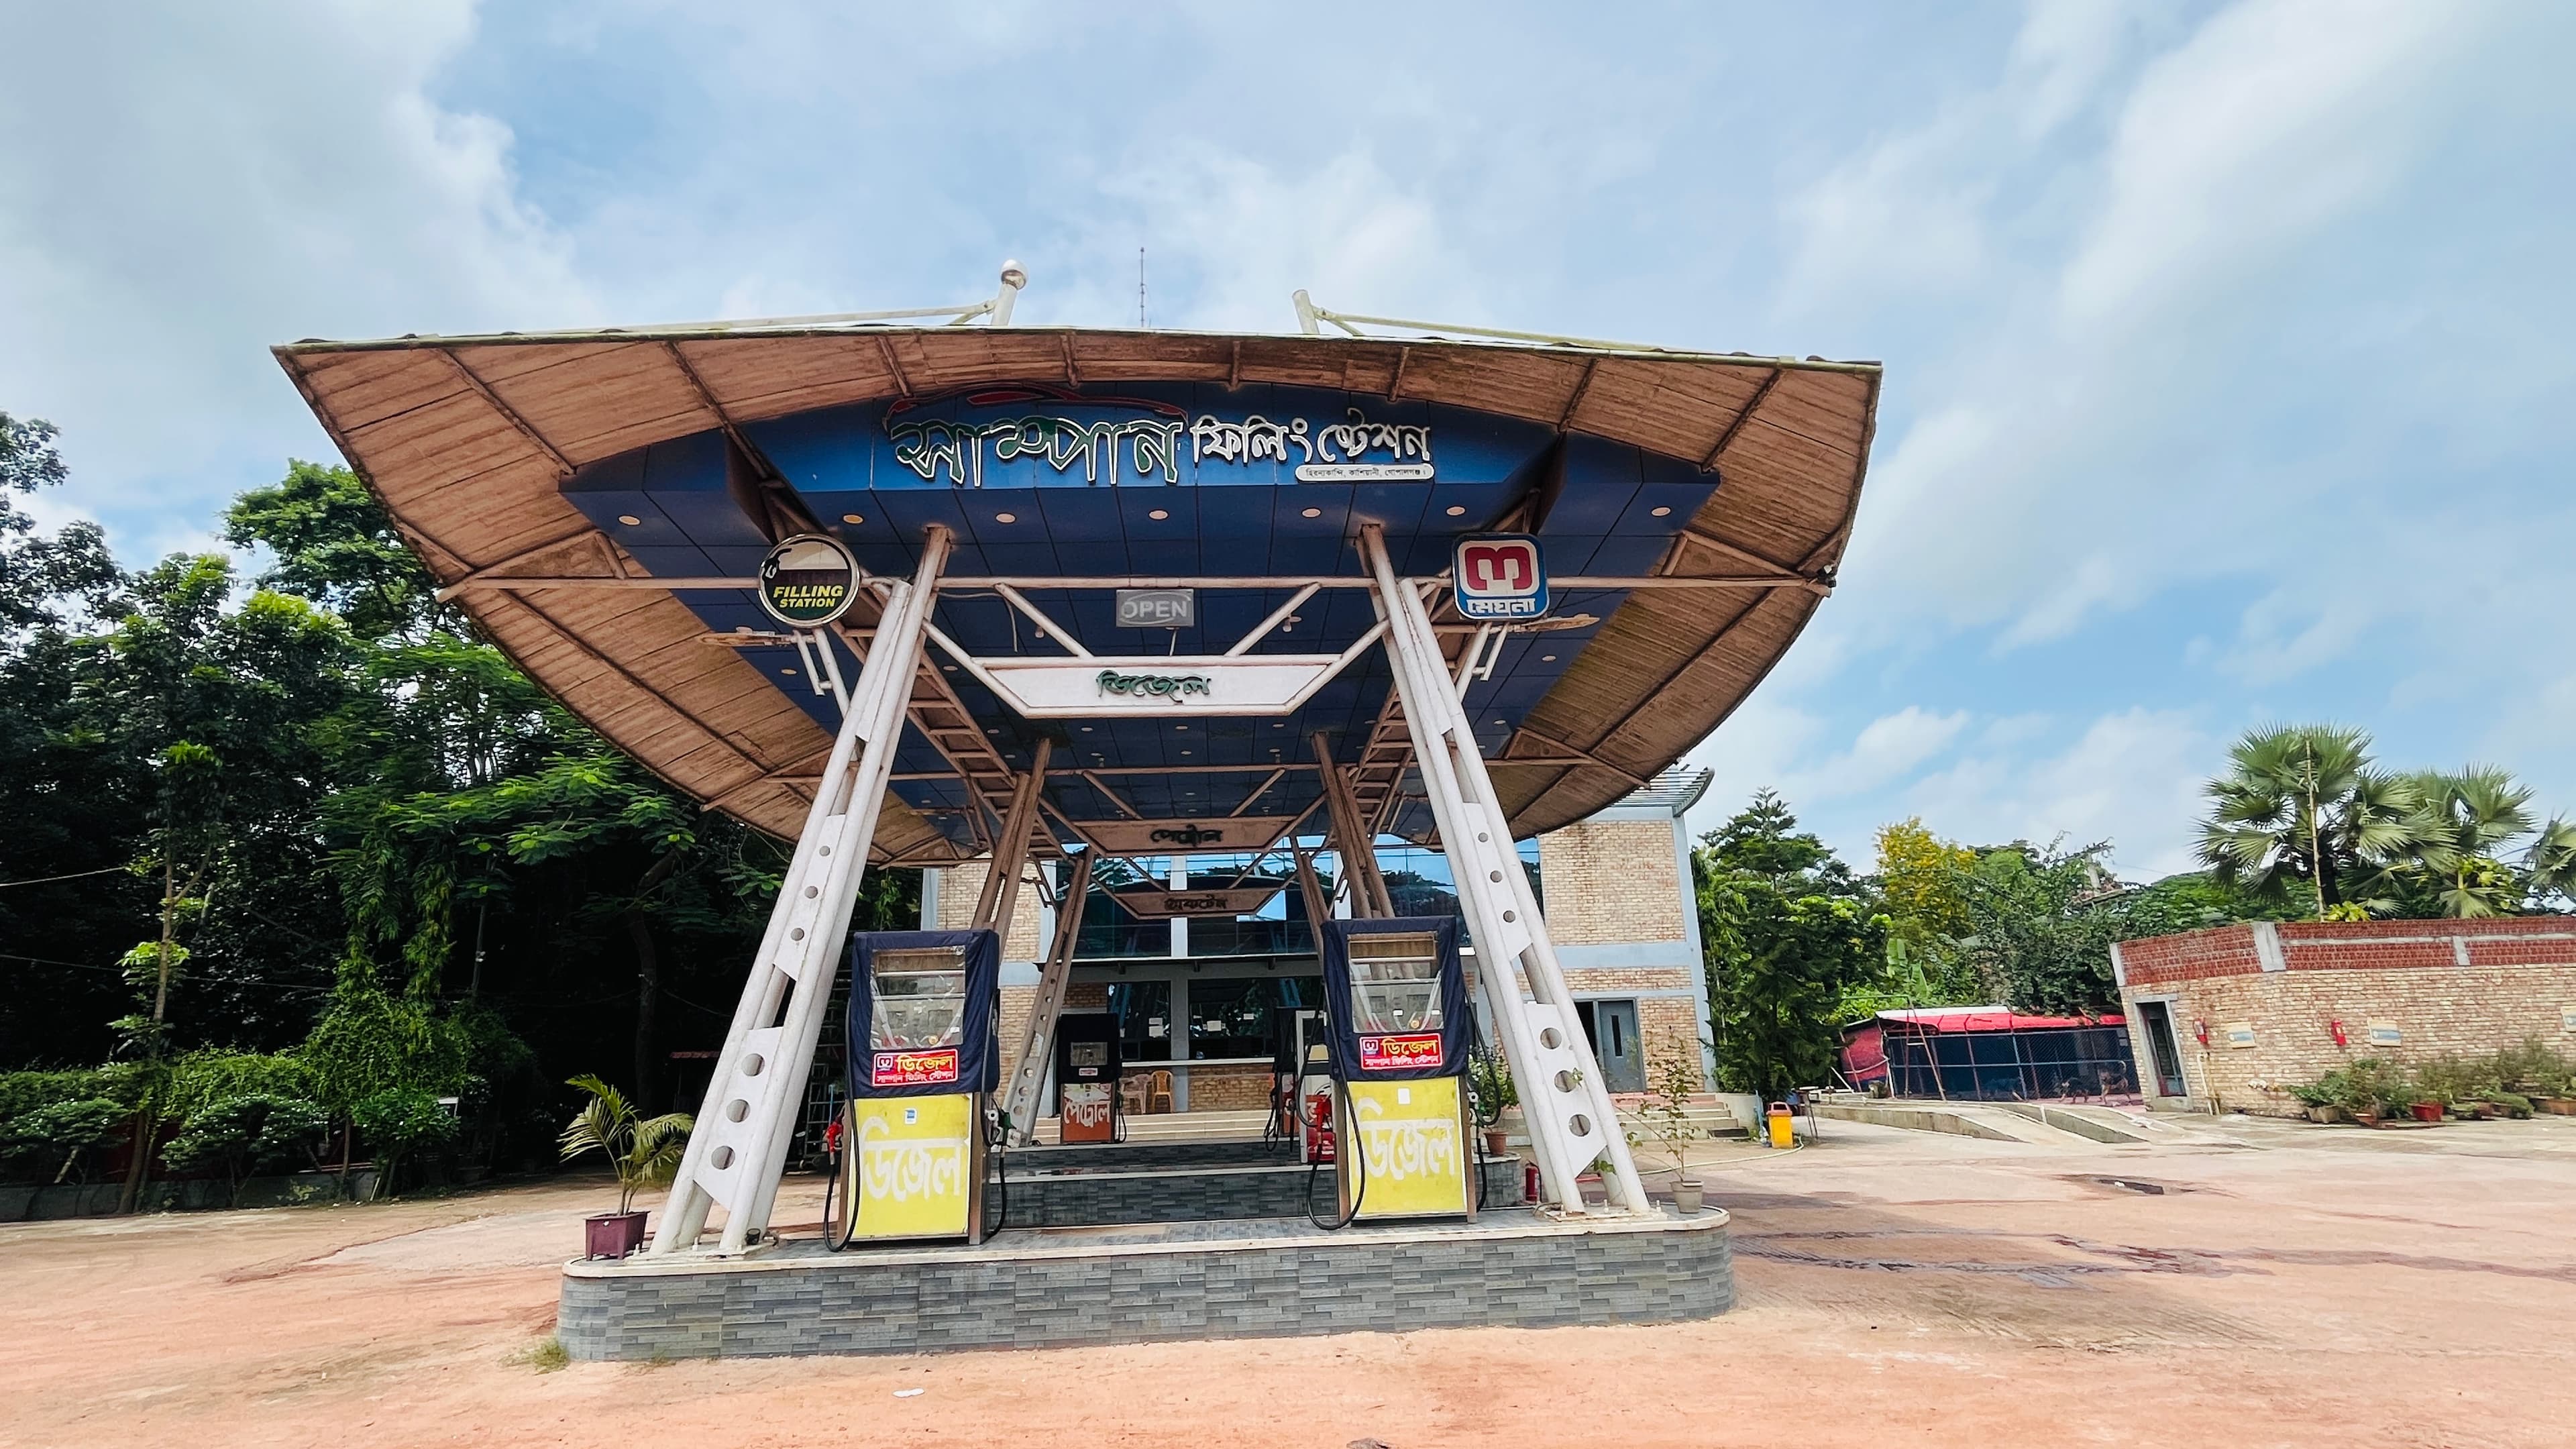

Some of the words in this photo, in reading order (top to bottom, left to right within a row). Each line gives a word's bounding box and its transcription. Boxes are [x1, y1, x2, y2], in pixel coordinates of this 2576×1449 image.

[890, 416, 1183, 487] সাম্পান
[1189, 415, 1313, 464] ফিলিং
[773, 584, 843, 598] FILLING
[780, 598, 836, 608] STATION
[1121, 600, 1187, 619] OPEN
[1466, 598, 1536, 616] মেঘনা
[1095, 669, 1212, 703] ডিজেল
[1380, 1038, 1438, 1057] ডিজেল
[895, 1055, 955, 1073] ডিজেল
[1355, 1097, 1455, 1181] ডিজেল
[858, 1116, 966, 1202] ডিজেল
